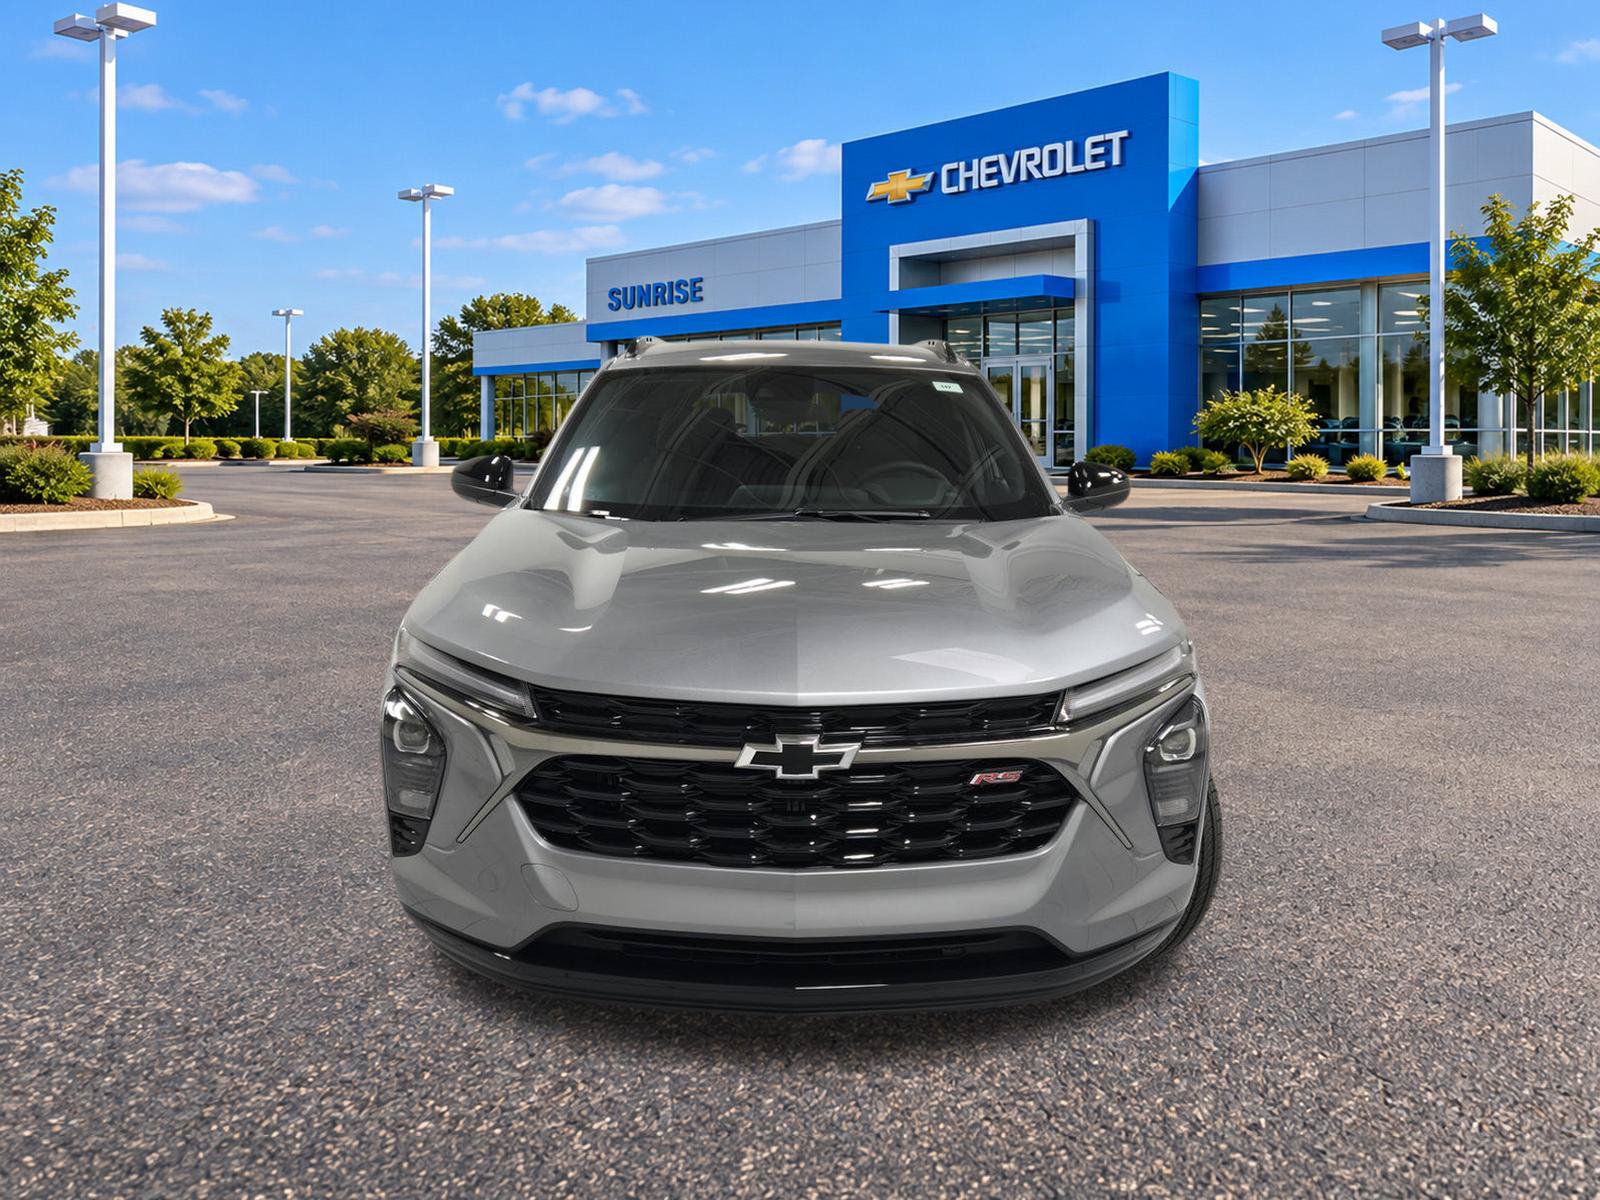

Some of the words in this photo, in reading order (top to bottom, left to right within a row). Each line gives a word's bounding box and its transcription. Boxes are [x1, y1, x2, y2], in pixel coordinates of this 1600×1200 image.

[941, 130, 1129, 194] CHEVROLET
[608, 277, 703, 311] SUNRISE
[969, 770, 1023, 784] RS
